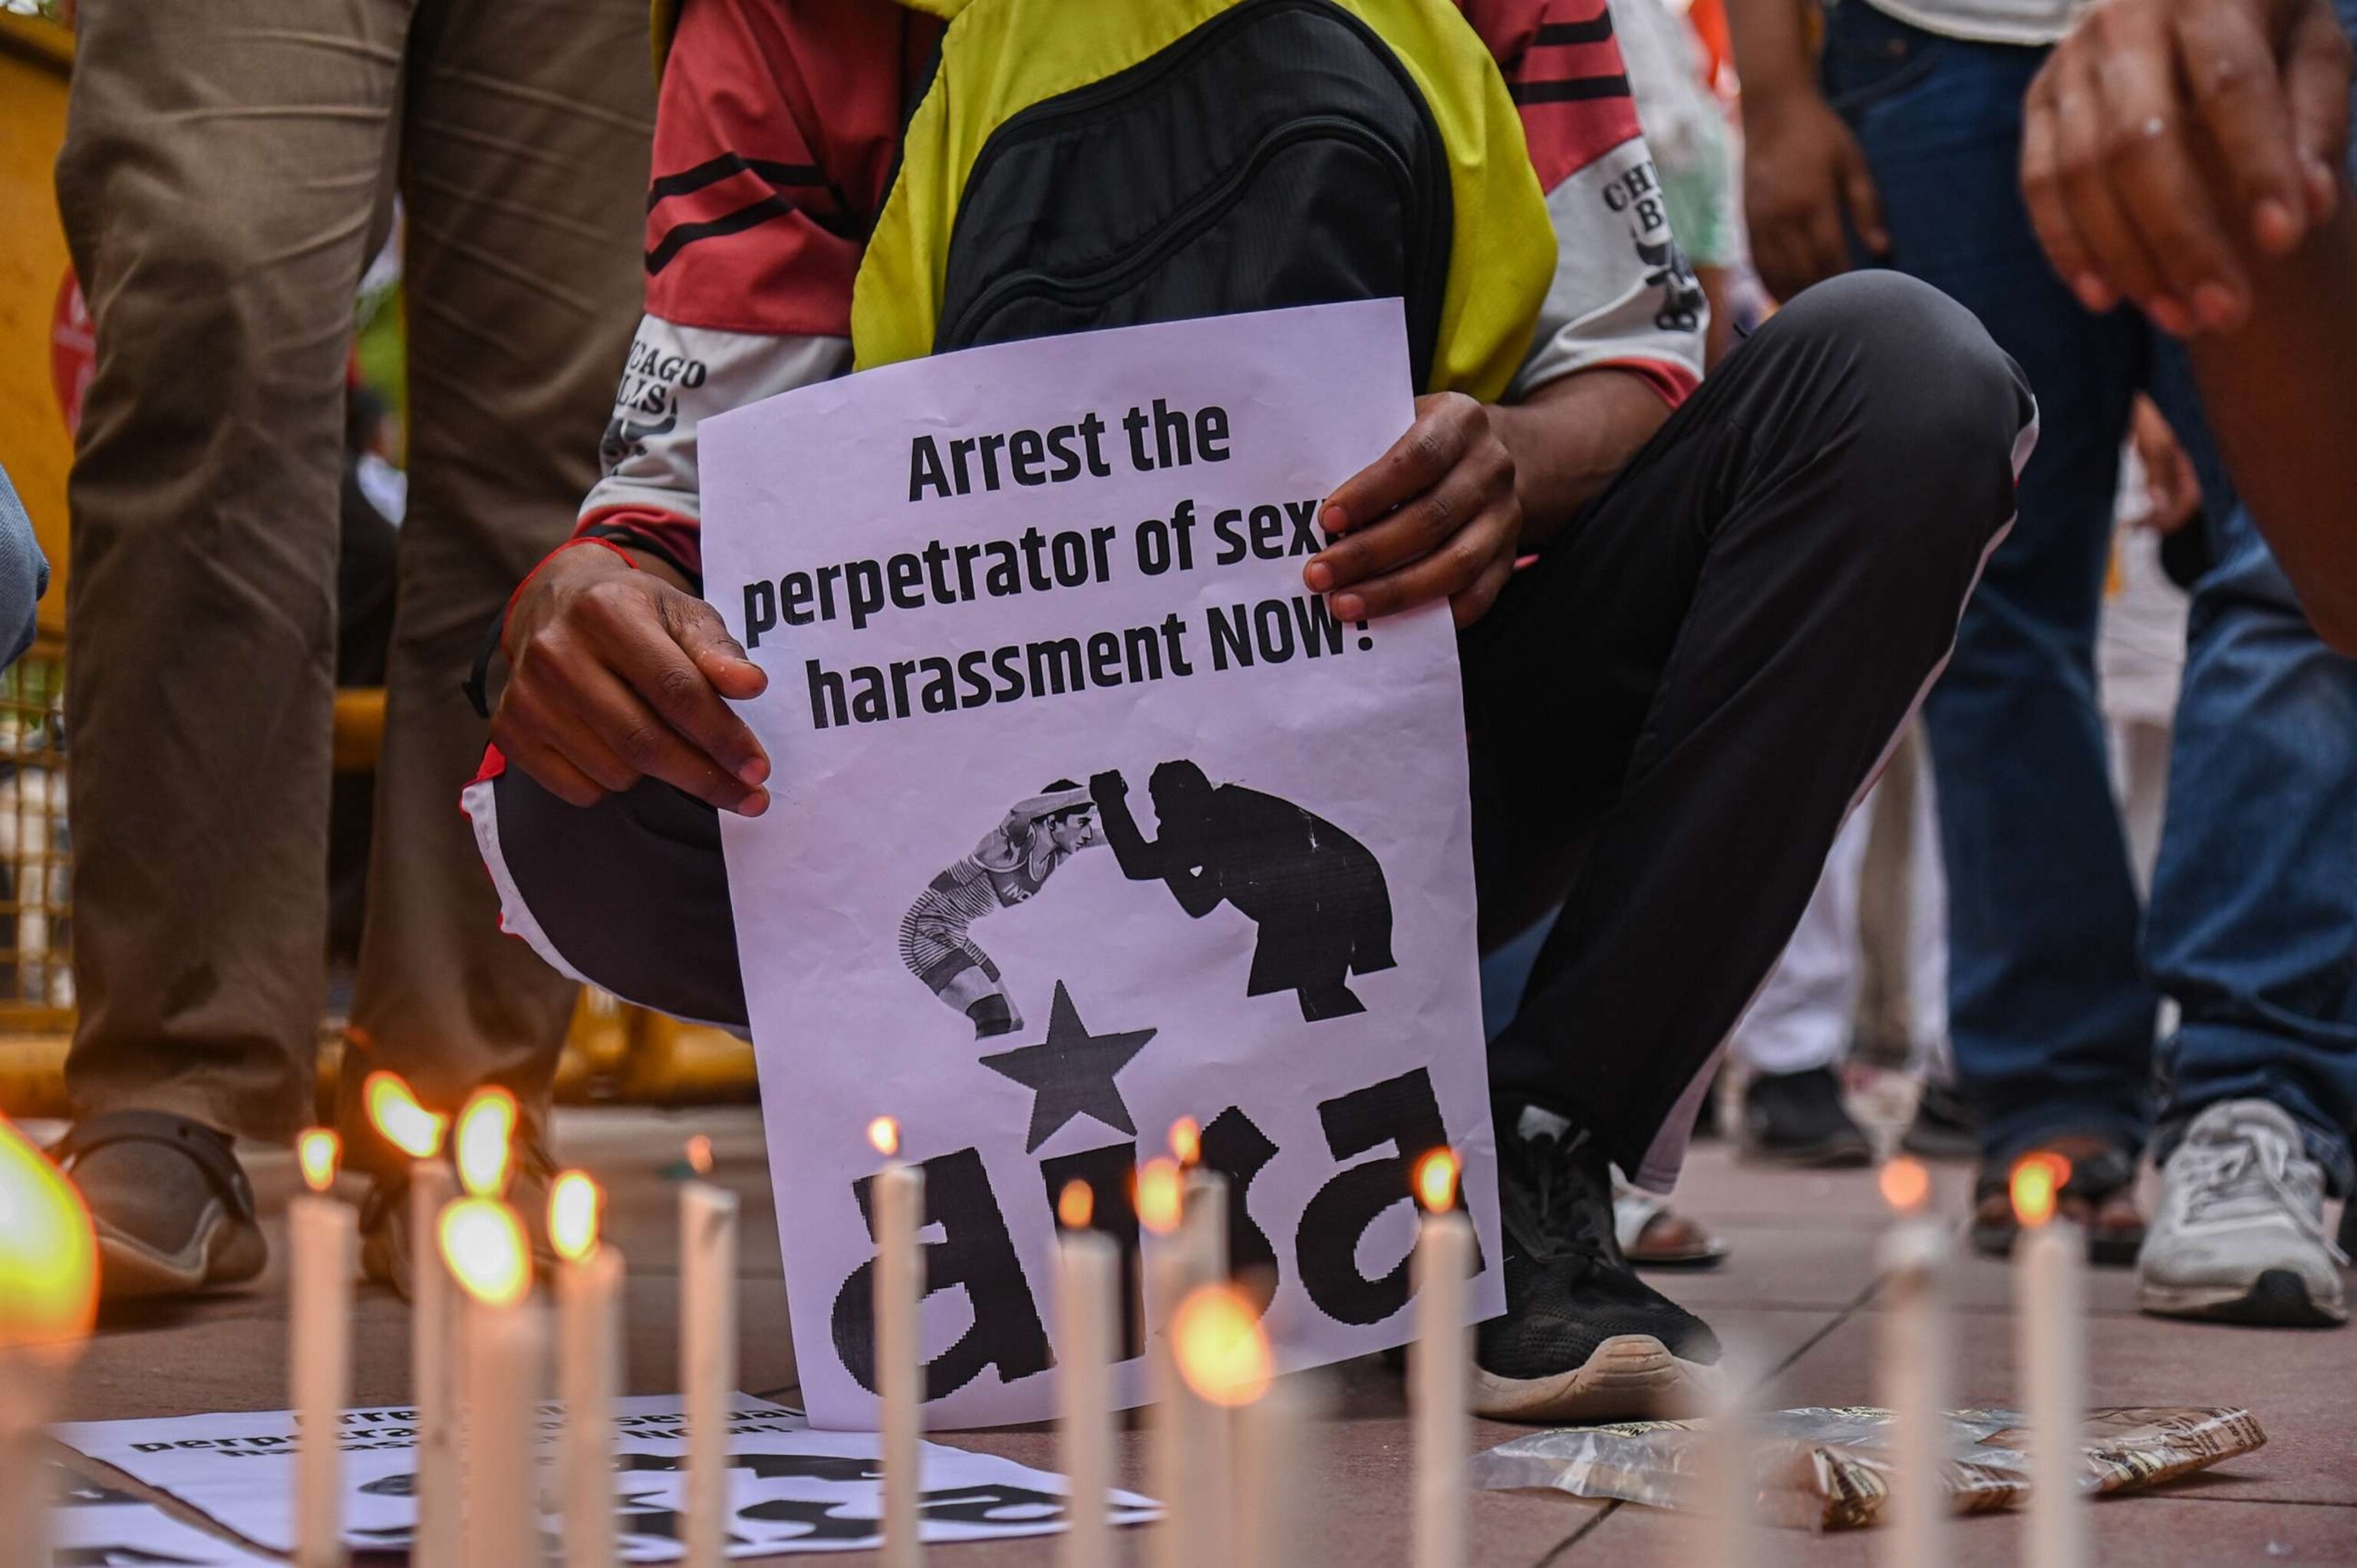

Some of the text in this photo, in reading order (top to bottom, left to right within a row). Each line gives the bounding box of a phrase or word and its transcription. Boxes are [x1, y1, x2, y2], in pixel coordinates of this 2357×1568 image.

[909, 398, 1231, 502] Arrest the
[743, 499, 1344, 650] perpetrator of sex
[805, 594, 1374, 730] harassment NOW!
